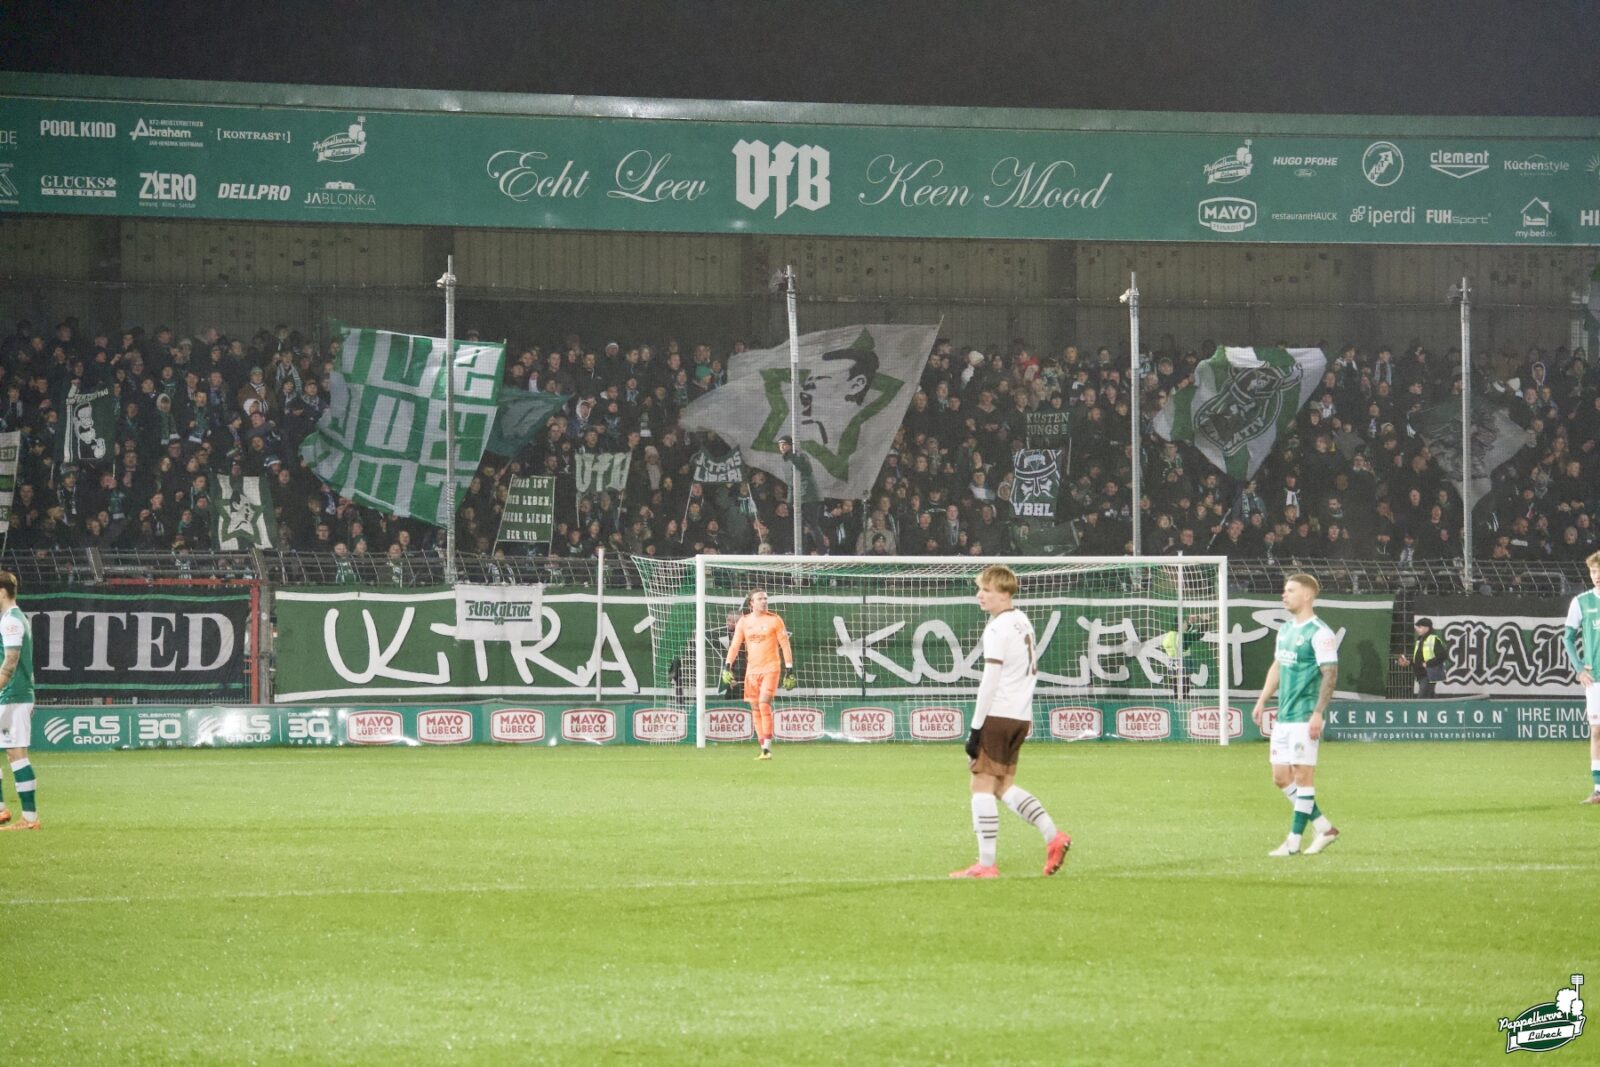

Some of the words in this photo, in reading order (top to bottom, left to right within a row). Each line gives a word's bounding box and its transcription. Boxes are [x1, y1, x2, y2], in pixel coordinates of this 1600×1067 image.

[129, 118, 191, 140] Abraham
[0, 130, 17, 144] DE
[1273, 156, 1302, 165] HUGO
[1304, 157, 1338, 166] PFOHE
[1430, 150, 1490, 164] clement
[486, 150, 591, 202] Echt
[607, 149, 710, 202] Leev
[858, 154, 974, 207] Keen
[983, 156, 1112, 209] Mood
[218, 183, 292, 200] DELLPRO
[304, 192, 376, 206] JABLONKA
[1204, 206, 1251, 220] MAYO
[1368, 206, 1415, 228] iperdi
[533, 478, 548, 488] IST
[1013, 502, 1054, 517] VBHL
[526, 512, 552, 524] LIEBE
[26, 611, 235, 672] ITED
[1444, 620, 1585, 687] HAL
[426, 715, 463, 725] MAYO
[500, 714, 536, 724] MAYO
[571, 714, 606, 724] MAYO
[642, 714, 678, 723] MAYO
[710, 714, 745, 723] MAYO
[781, 713, 815, 723] MAYO
[851, 713, 885, 723] MAYO
[920, 713, 955, 723] MAYO
[1059, 712, 1094, 722] MAYO
[1126, 712, 1162, 722] MAYO
[1329, 710, 1503, 724] KENSINGTON
[1517, 708, 1551, 721] IHRE
[1556, 708, 1588, 721] IMM
[73, 716, 120, 734] FLS
[356, 716, 393, 726] MAYO
[851, 723, 885, 731] LÜBECK
[138, 719, 182, 740] 30
[288, 718, 330, 738] 30
[427, 726, 463, 734] LÜBECK
[501, 725, 535, 733] LÜBECK
[571, 724, 606, 732] LÜBECK
[710, 724, 744, 732] LÜBECK
[1517, 724, 1532, 738] IN
[1538, 725, 1567, 738] DER
[1572, 722, 1590, 738] LÜ
[73, 736, 120, 744] GROUP
[1373, 732, 1424, 740] Properties
